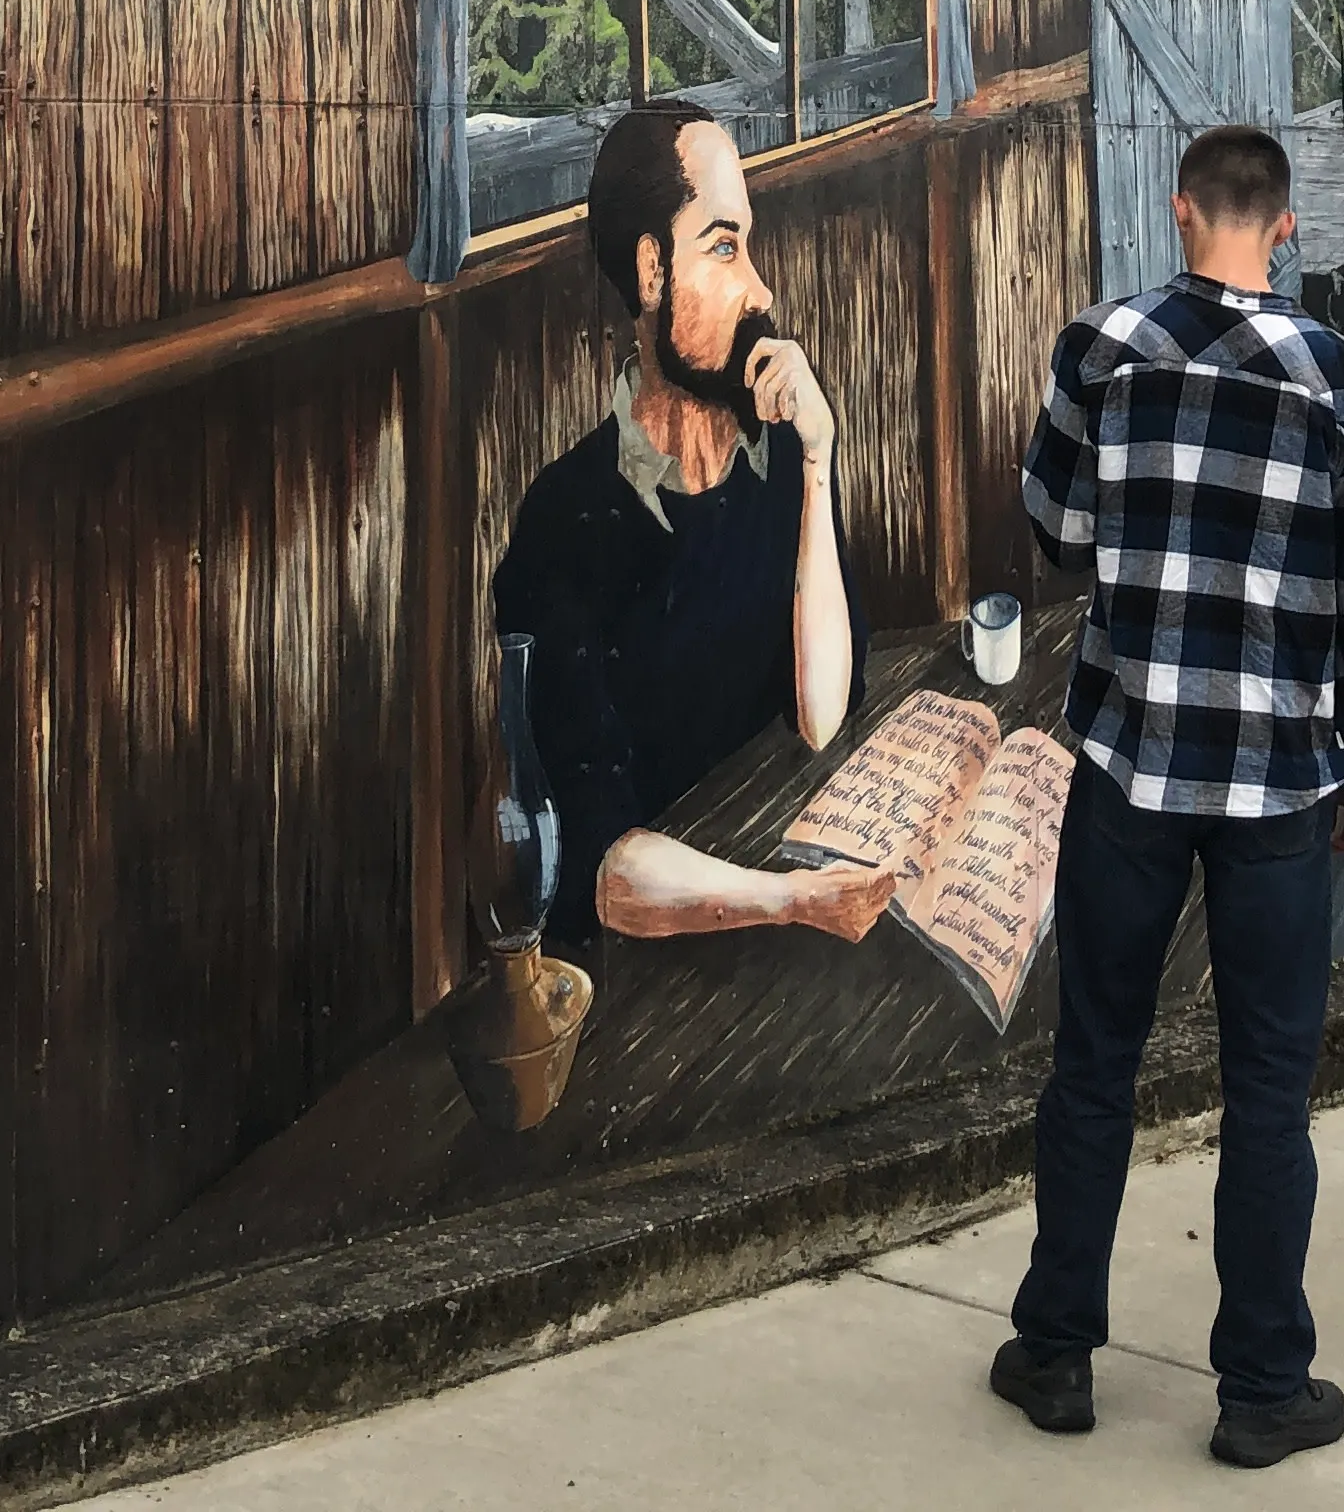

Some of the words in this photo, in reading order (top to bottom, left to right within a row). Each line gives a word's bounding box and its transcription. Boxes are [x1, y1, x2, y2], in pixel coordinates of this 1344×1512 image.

[920, 743, 930, 754] a
[886, 753, 906, 775] my
[866, 791, 888, 814] the
[800, 807, 830, 826] and
[818, 811, 881, 850] presently
[874, 826, 897, 862] they
[937, 880, 989, 908] grateful
[1008, 878, 1028, 904] the
